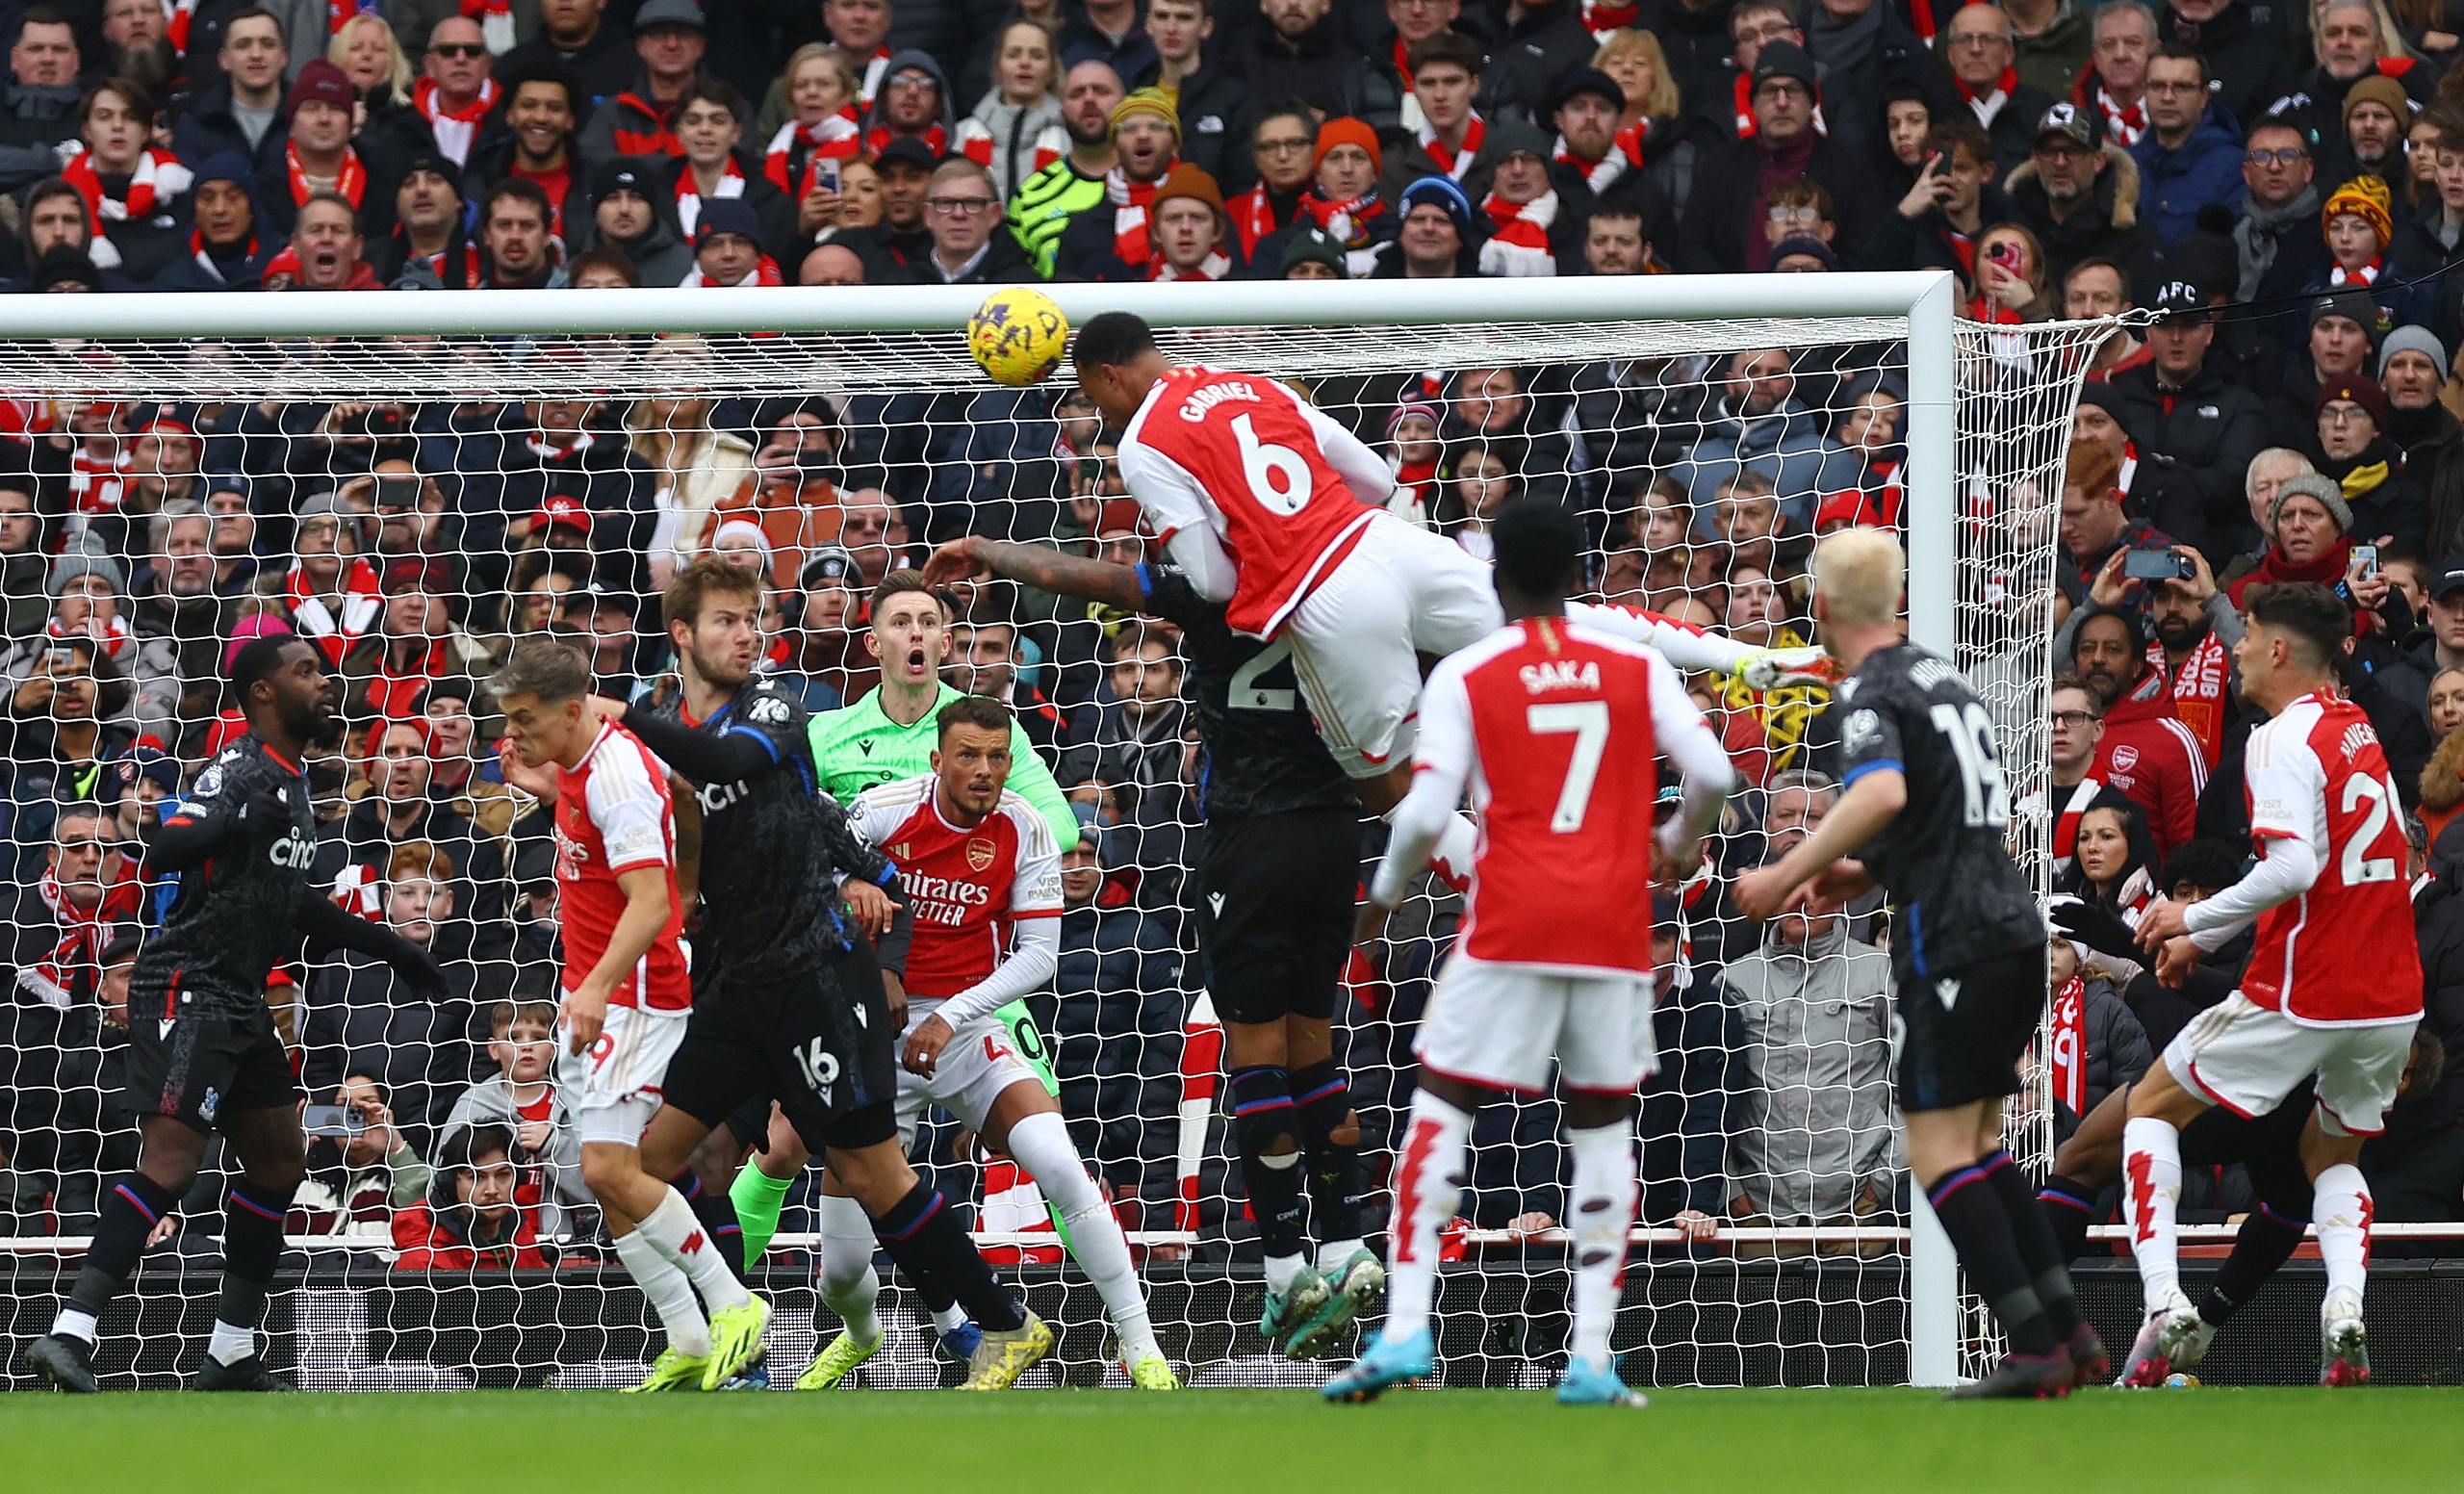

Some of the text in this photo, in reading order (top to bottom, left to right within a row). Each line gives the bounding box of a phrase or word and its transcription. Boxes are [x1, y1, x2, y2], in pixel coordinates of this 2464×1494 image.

[2156, 281, 2196, 304] AFC
[1179, 381, 1262, 423] GABRIEL
[1230, 412, 1313, 517] 6
[1519, 660, 1601, 696] SAKA
[2200, 644, 2223, 699] CLUB
[1526, 700, 1611, 835] 7
[1929, 702, 2011, 828] 19
[895, 868, 989, 905] mirates
[792, 1035, 840, 1091] 16
